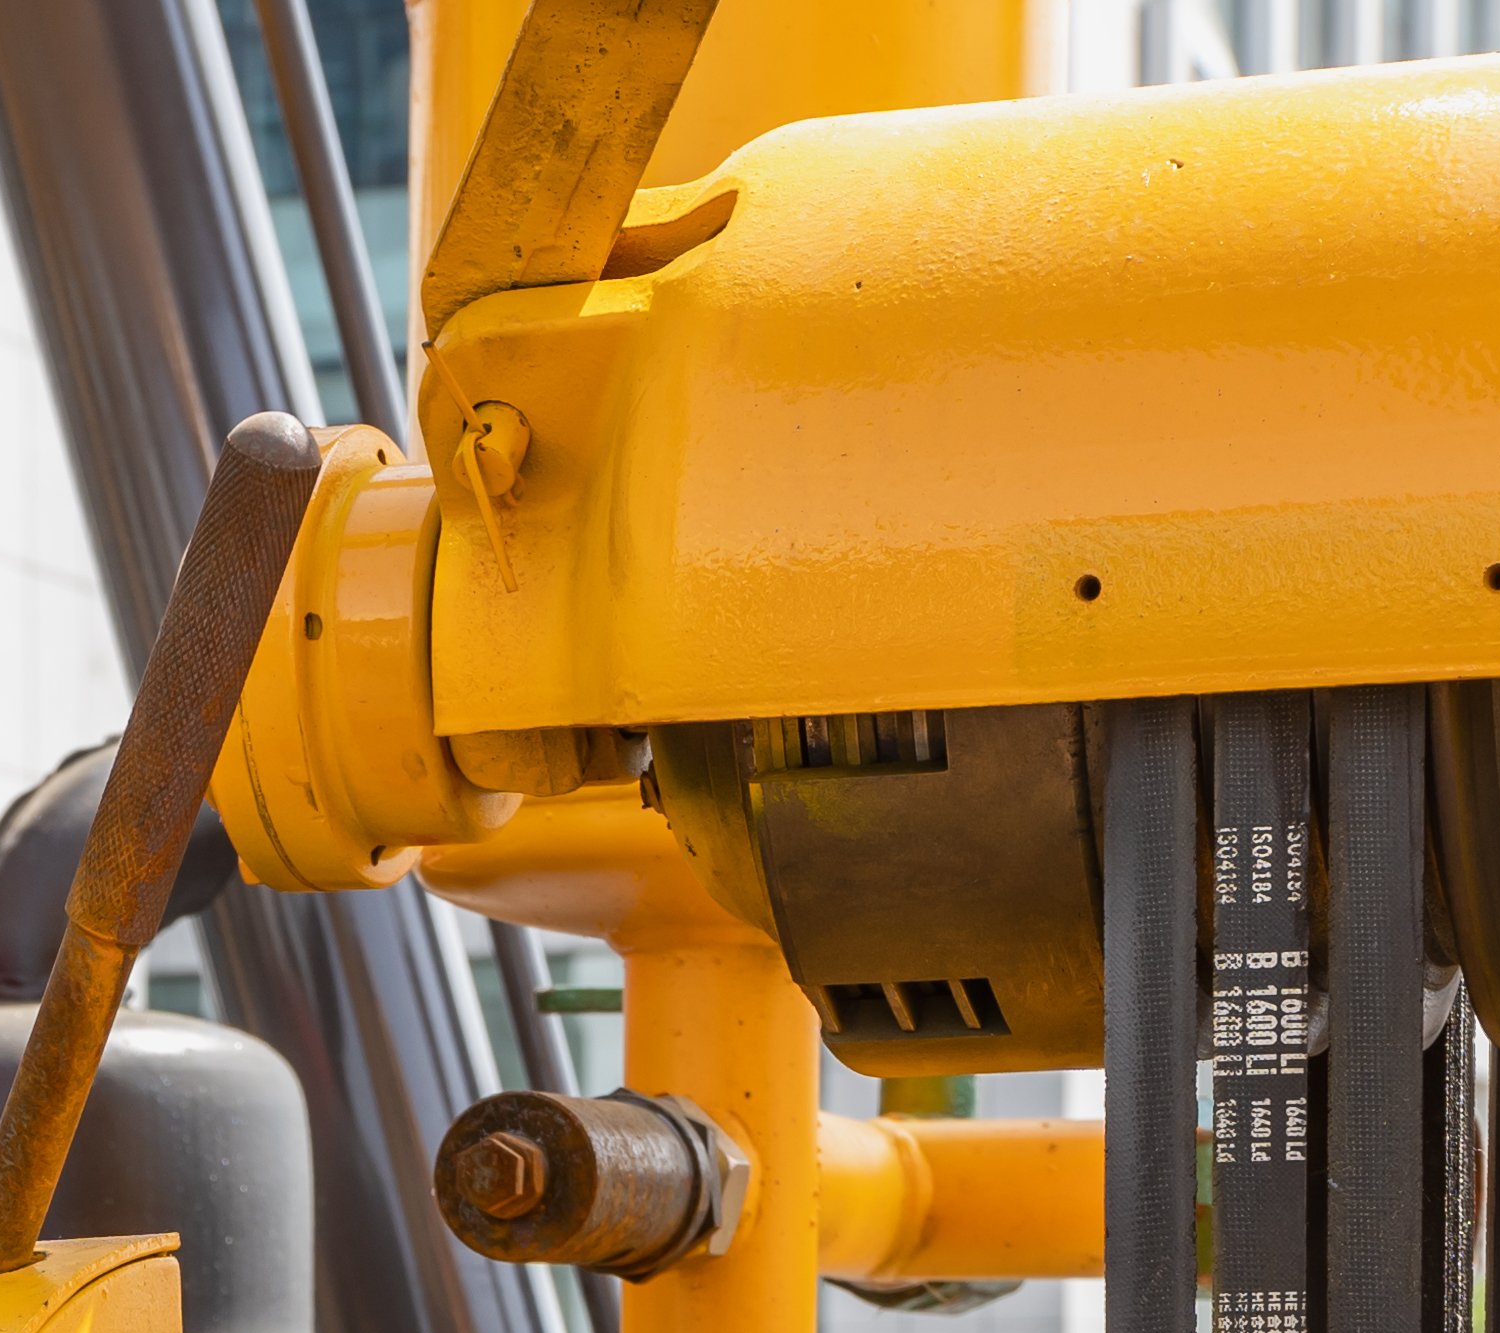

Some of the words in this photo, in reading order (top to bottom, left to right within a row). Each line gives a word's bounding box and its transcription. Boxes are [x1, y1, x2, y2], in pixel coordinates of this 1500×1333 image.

[1252, 825, 1273, 904] ISO4184
[1246, 951, 1278, 969] B
[1246, 984, 1278, 1046] 1600
[1246, 1053, 1278, 1076] Li
[1250, 1097, 1272, 1138] 1640
